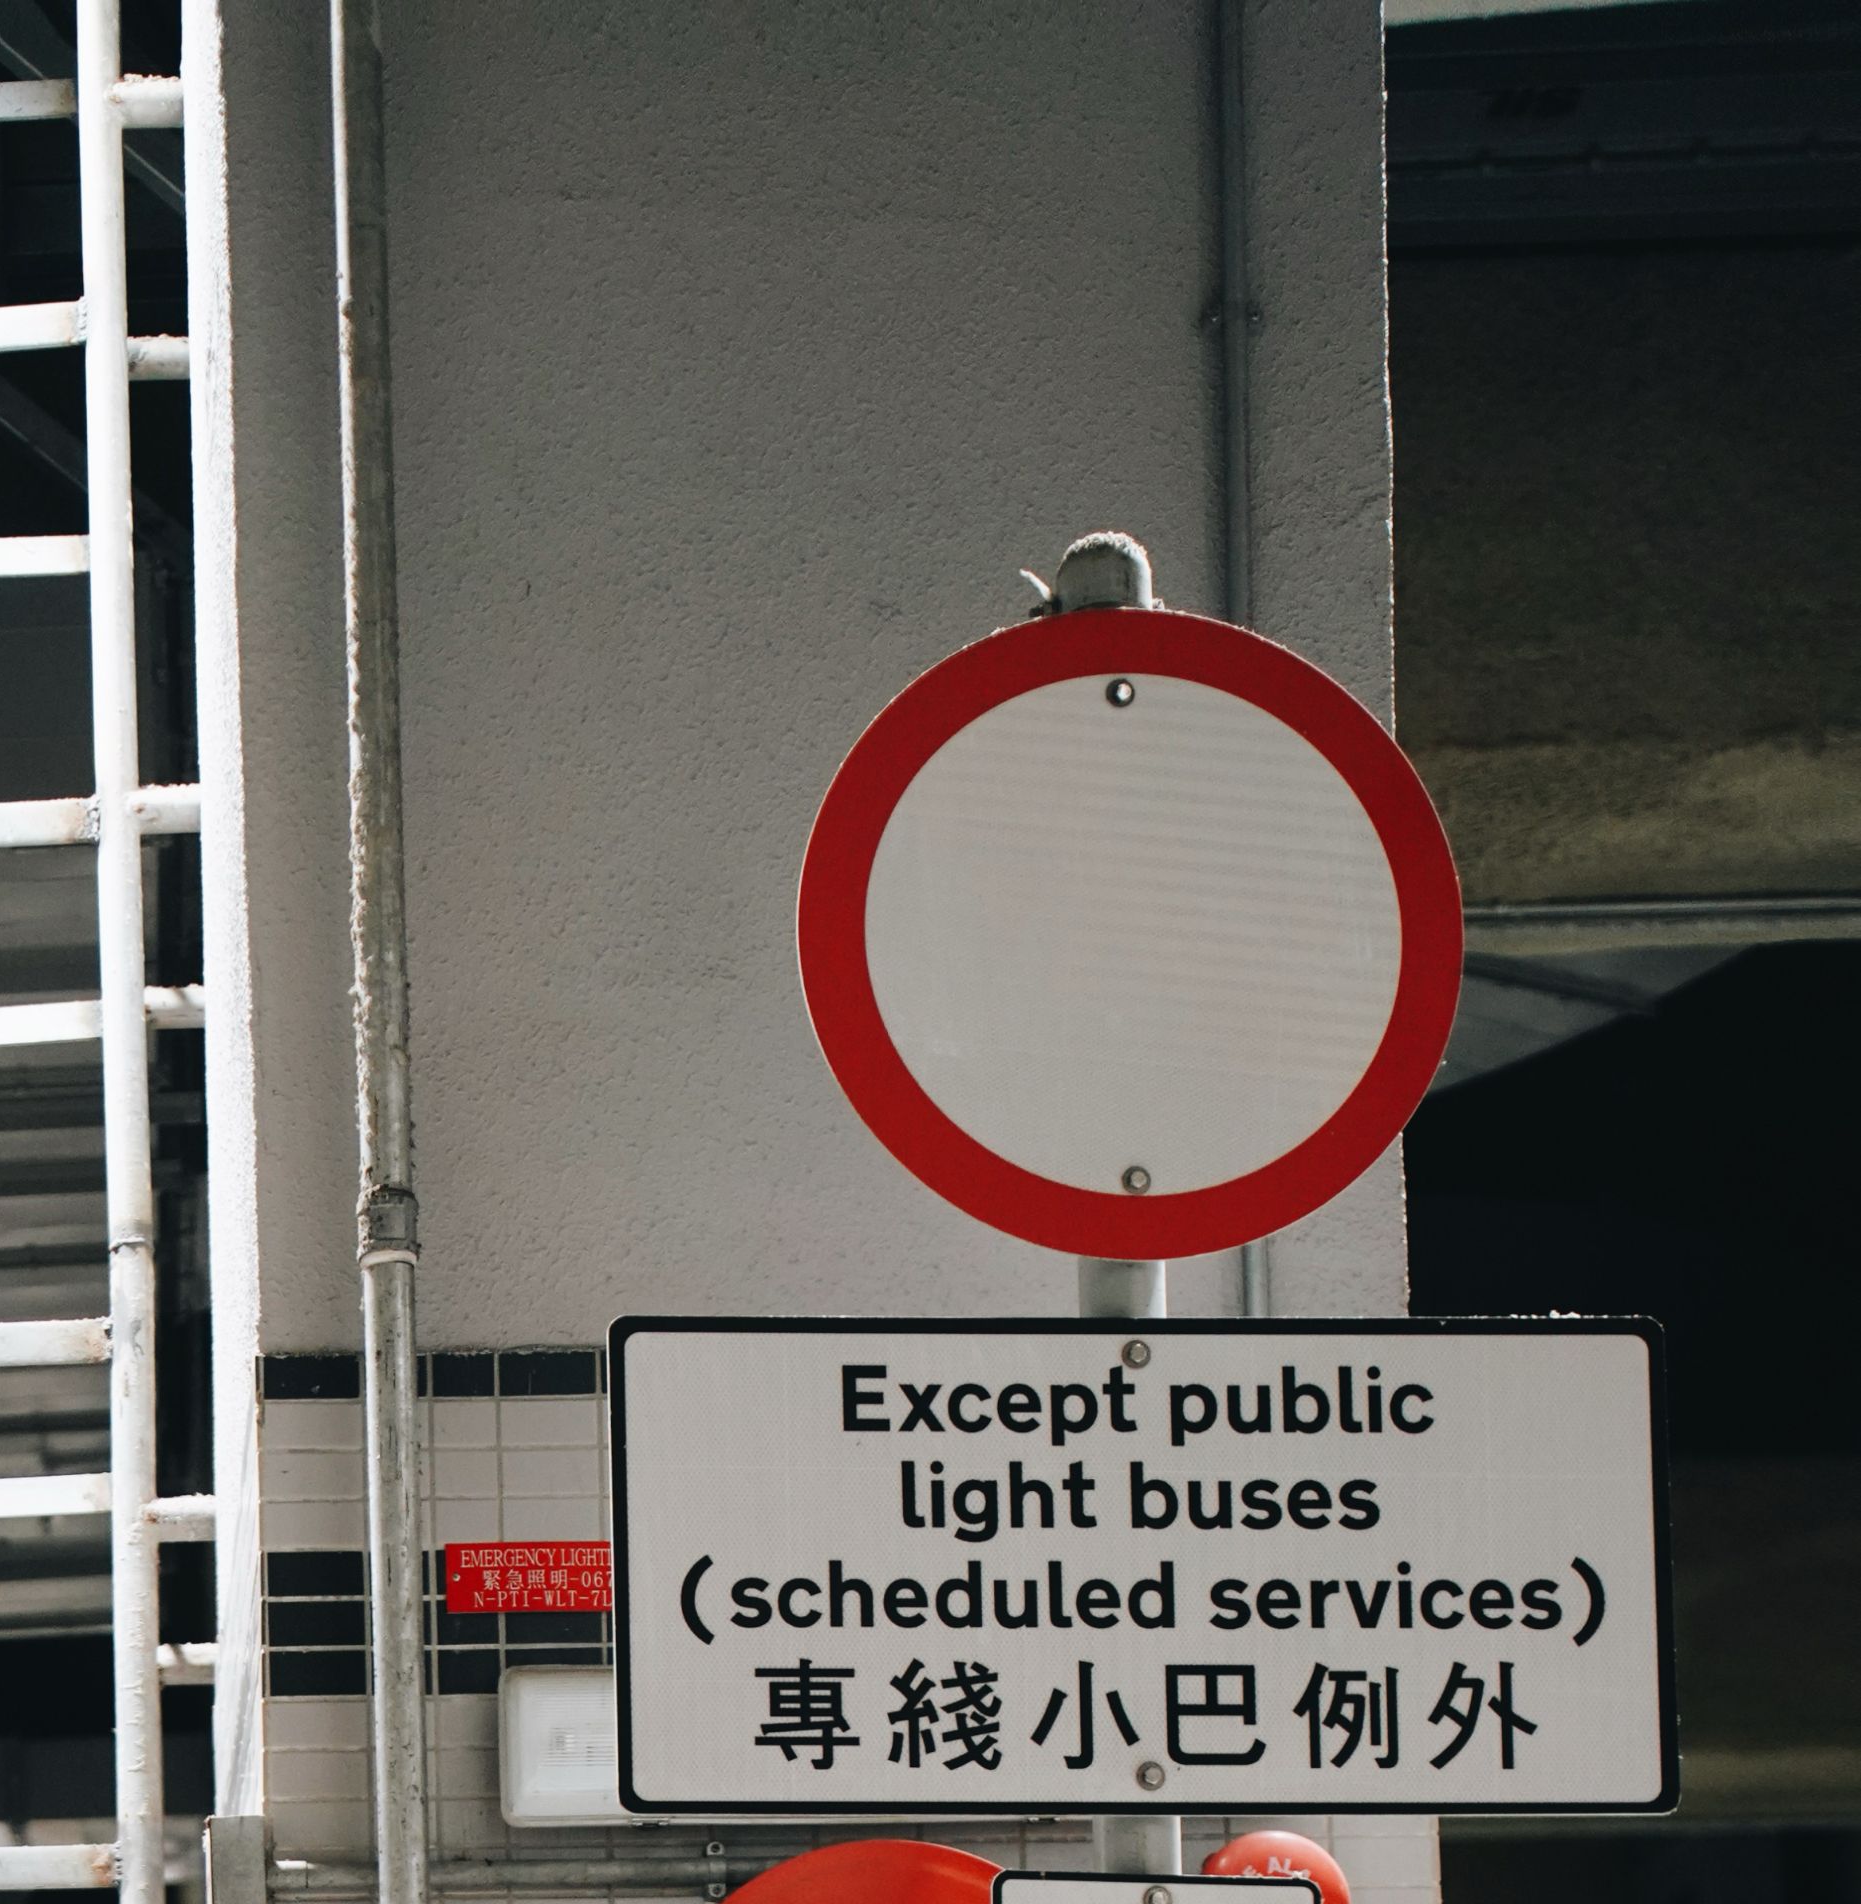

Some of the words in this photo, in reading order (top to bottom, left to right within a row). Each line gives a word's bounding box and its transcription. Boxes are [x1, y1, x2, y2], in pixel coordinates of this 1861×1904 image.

[842, 1365, 1138, 1447] Except
[1170, 1365, 1435, 1447] public
[900, 1460, 1098, 1543] light
[1130, 1460, 1381, 1531] buses
[460, 1548, 557, 1568] EMERGENCY
[680, 1554, 1176, 1646] (scheduled
[1209, 1556, 1606, 1647] services)
[754, 1658, 1538, 1771] 專綫小巴例外
